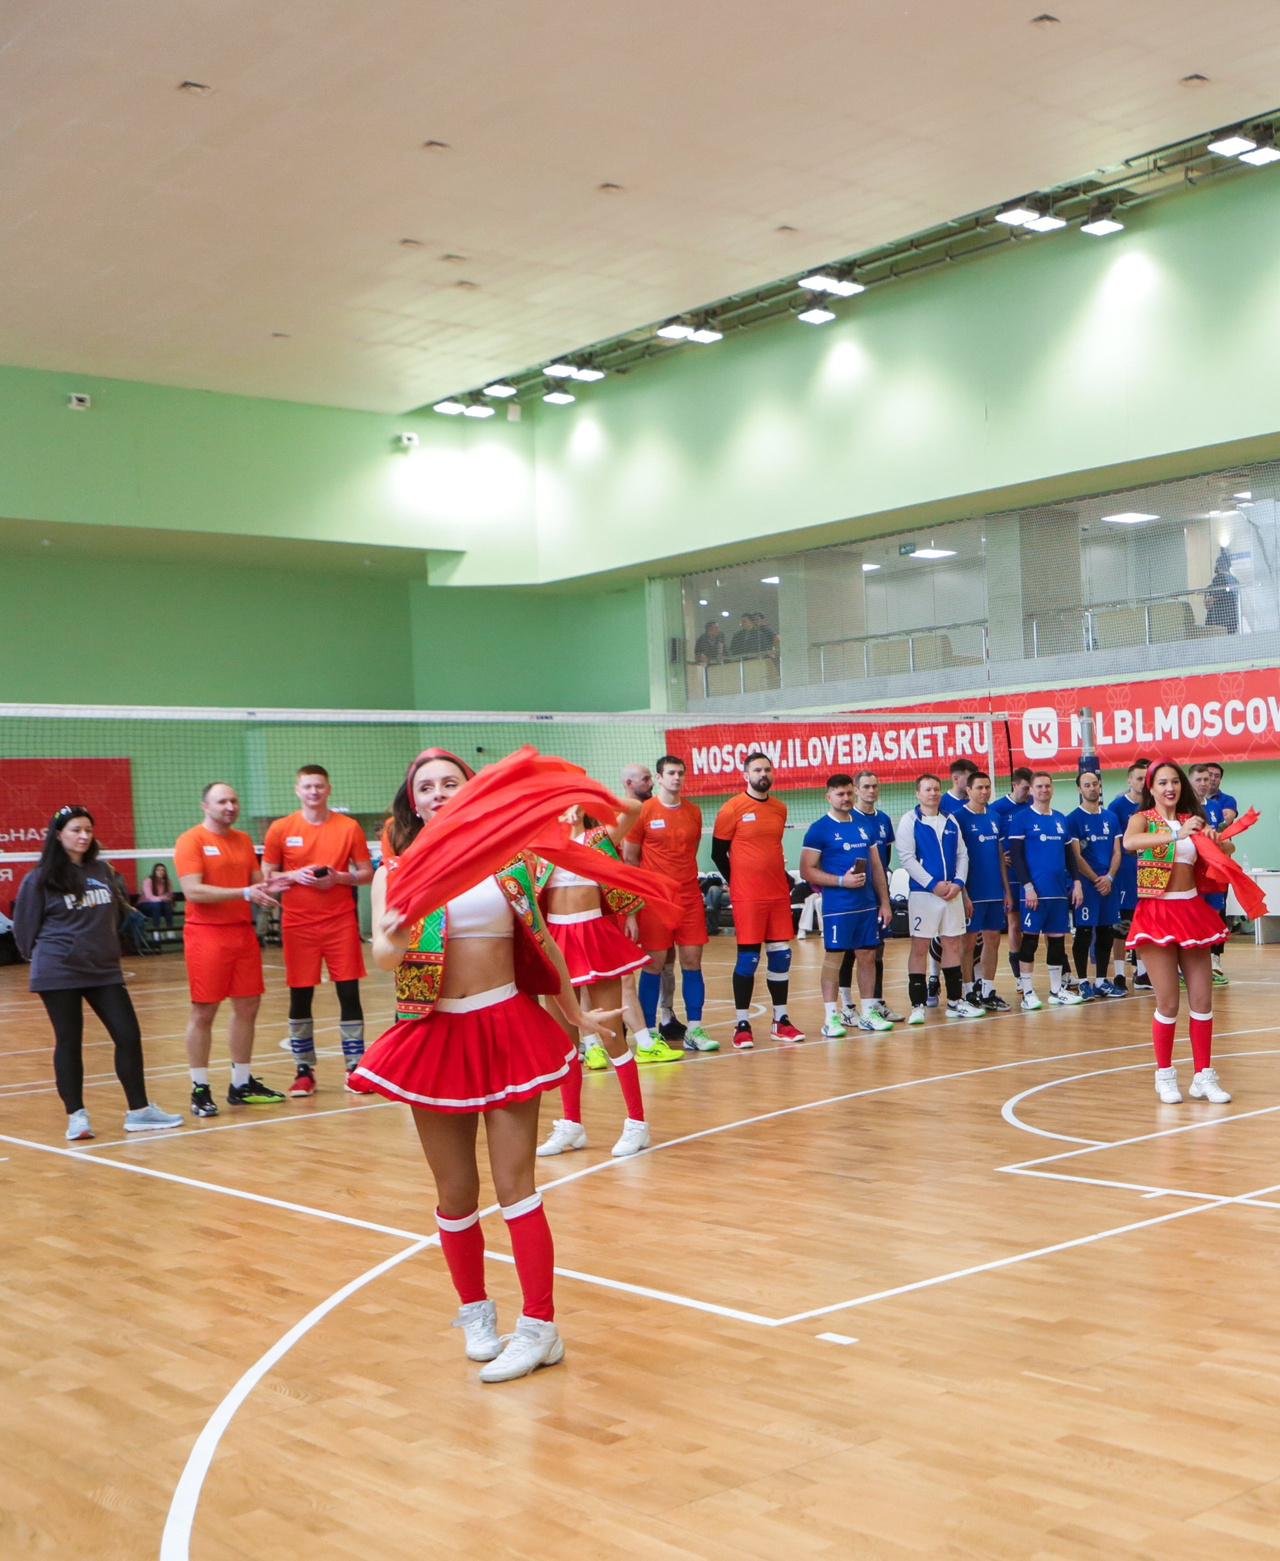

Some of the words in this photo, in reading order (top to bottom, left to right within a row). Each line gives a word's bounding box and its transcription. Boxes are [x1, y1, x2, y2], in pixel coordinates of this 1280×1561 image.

[1029, 722, 1052, 744] VK
[1120, 891, 1126, 904] 7
[1024, 912, 1032, 927] 4
[1082, 907, 1089, 920] 8
[914, 916, 922, 931] 2
[832, 925, 838, 938] 1
